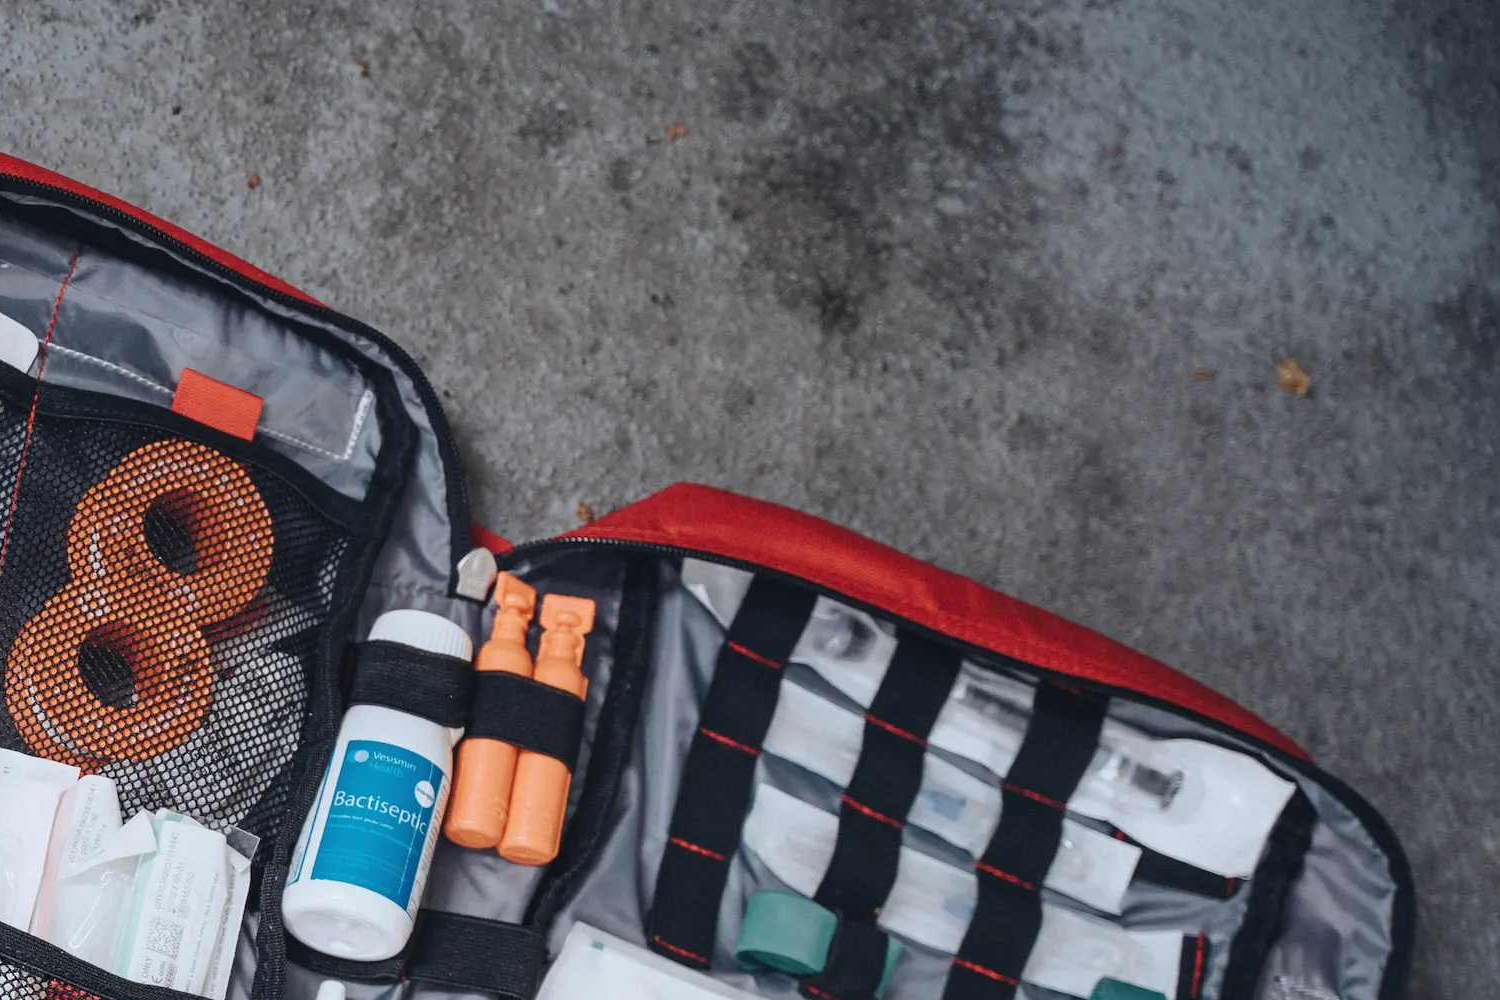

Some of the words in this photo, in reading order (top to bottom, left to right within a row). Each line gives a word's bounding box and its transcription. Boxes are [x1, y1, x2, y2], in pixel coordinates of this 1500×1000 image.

[369, 761, 404, 777] Health
[373, 750, 417, 772] Vesismin
[333, 790, 427, 835] Bactiseptic
[141, 955, 152, 978] ONLY
